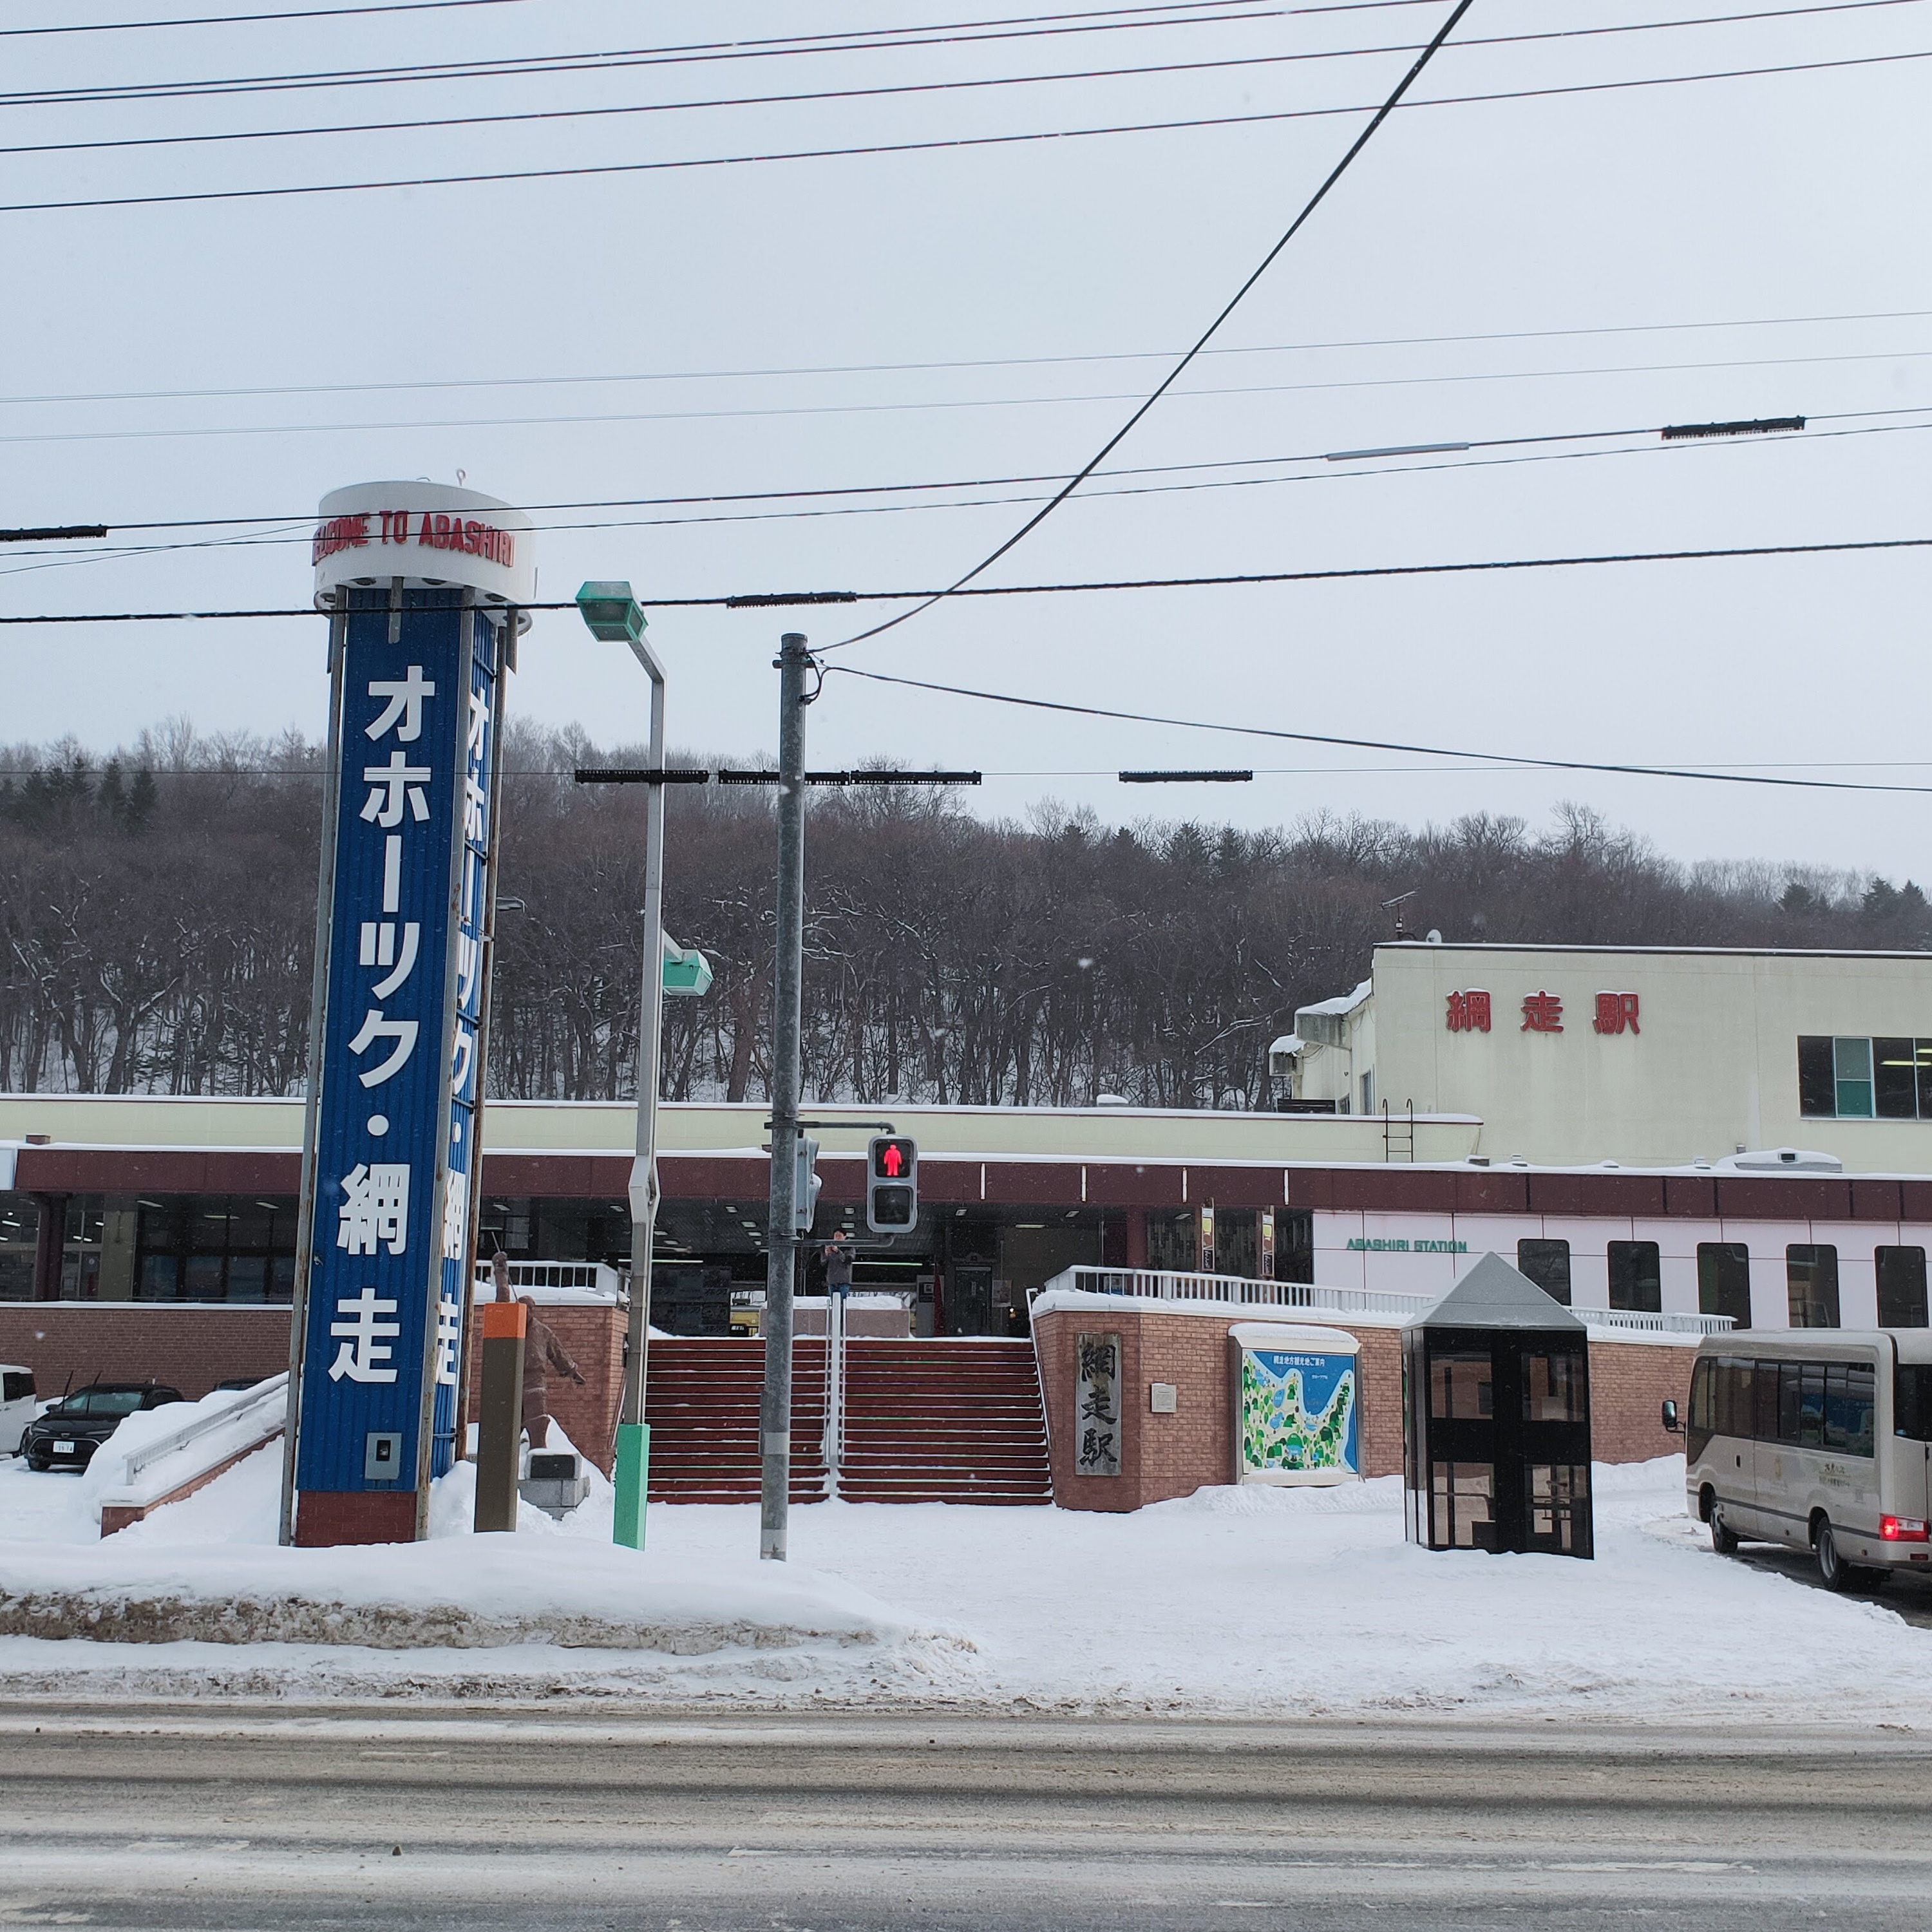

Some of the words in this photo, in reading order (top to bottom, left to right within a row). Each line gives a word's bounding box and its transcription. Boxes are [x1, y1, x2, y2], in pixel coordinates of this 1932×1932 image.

[312, 512, 370, 566] ELCOME
[379, 511, 408, 544] TO
[419, 513, 515, 567] ABASHIRI
[328, 665, 435, 1383] オホーツク・網走
[1445, 988, 1640, 1035] 網走駅
[1347, 1238, 1409, 1251] ABASHIRI
[1414, 1240, 1467, 1253] STATION
[1079, 1341, 1118, 1467] 網走駅
